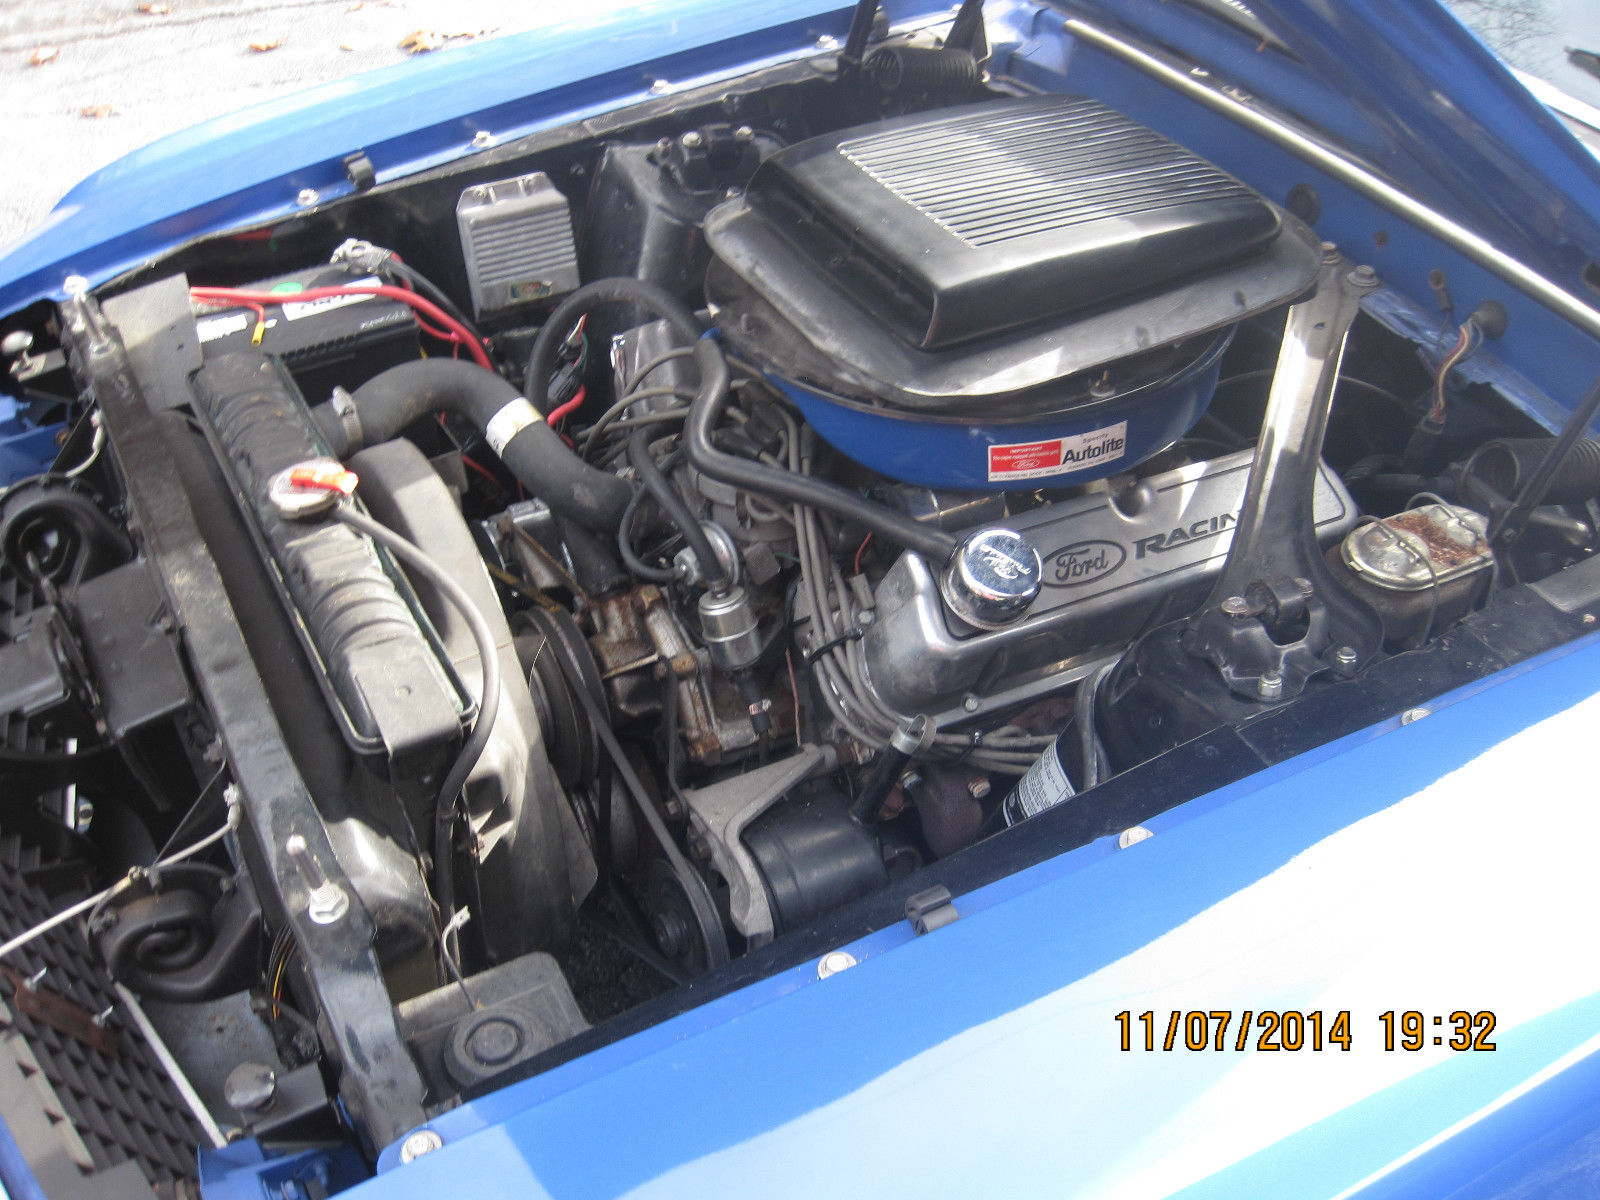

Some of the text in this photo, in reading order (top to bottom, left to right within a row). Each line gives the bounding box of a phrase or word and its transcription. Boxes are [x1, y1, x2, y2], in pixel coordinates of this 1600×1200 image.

[1062, 437, 1124, 465] Autolite
[1054, 548, 1109, 582] Ford
[1132, 512, 1239, 560] RACIN
